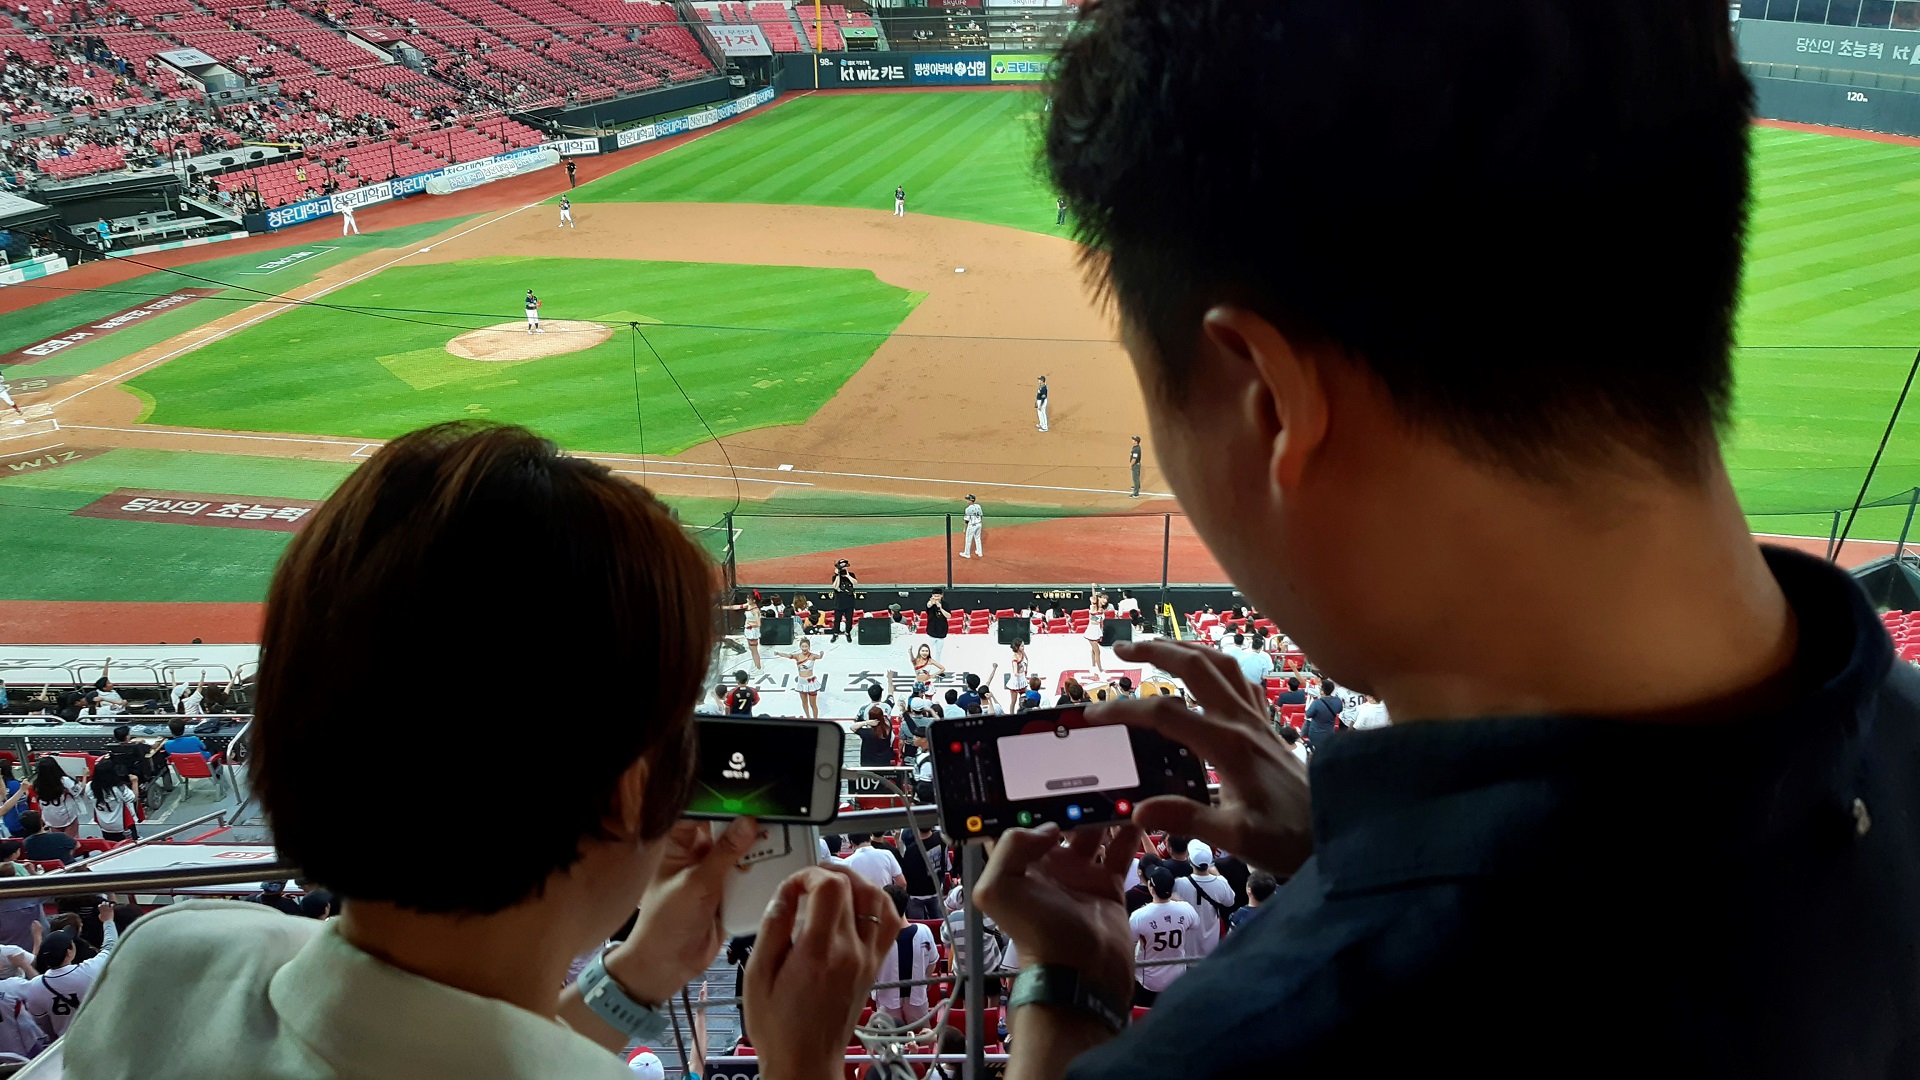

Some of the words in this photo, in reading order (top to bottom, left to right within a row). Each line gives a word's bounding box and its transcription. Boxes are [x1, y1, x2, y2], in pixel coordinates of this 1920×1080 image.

[1796, 37, 1835, 55] 당신의
[1838, 39, 1884, 60] 초능력
[1892, 45, 1911, 61] kt
[840, 66, 855, 81] kt
[856, 66, 880, 81] wiz
[881, 65, 905, 81] 카드
[914, 62, 930, 76] 평생
[967, 61, 986, 77] 신협
[619, 126, 654, 146] 청운대학교
[655, 117, 689, 137] 청운대학교
[689, 109, 719, 127] 청운대학교
[267, 200, 332, 228] 청운대학교
[8, 450, 82, 472] wiz
[120, 497, 212, 516] 당신의
[206, 501, 312, 523] 초능력
[738, 699, 747, 710] 7
[1349, 694, 1366, 708] 50
[1152, 929, 1183, 952] 50
